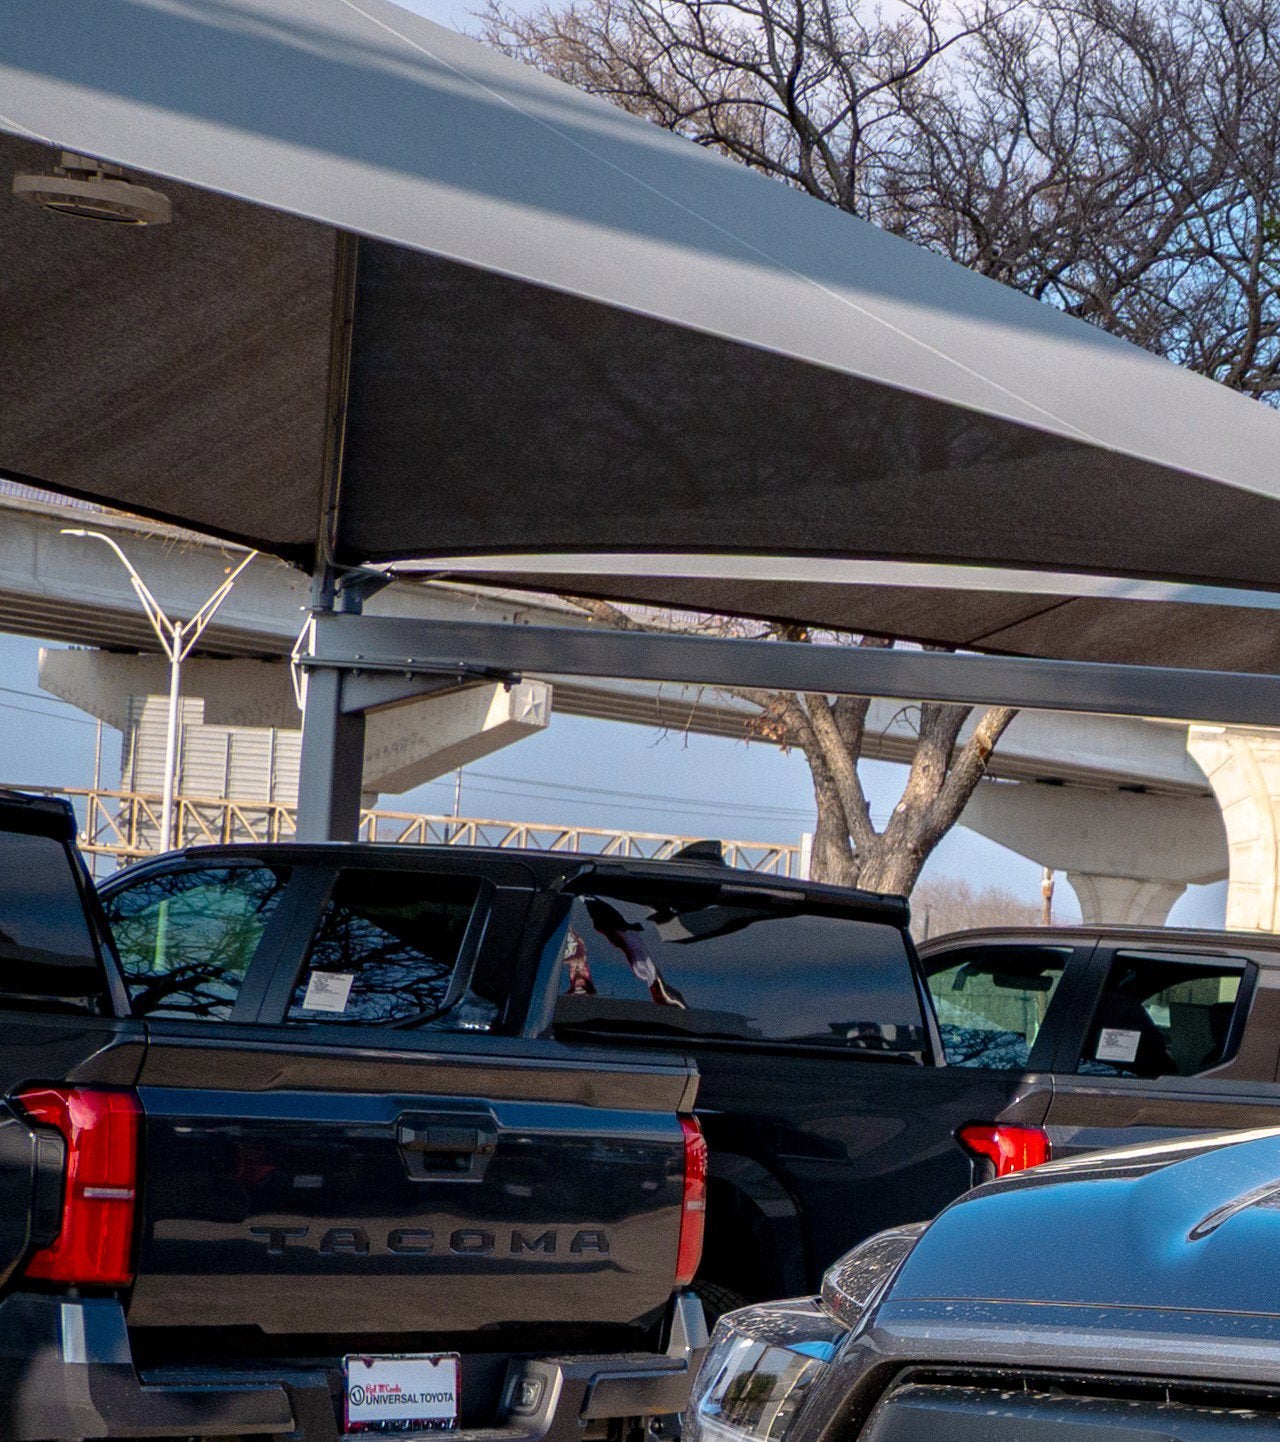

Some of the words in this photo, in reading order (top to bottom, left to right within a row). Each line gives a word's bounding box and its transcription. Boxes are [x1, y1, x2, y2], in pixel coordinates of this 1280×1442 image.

[249, 1226, 610, 1256] TACOMA
[366, 1393, 419, 1406] UNIVERSAL
[420, 1391, 455, 1403] TOYOTA
